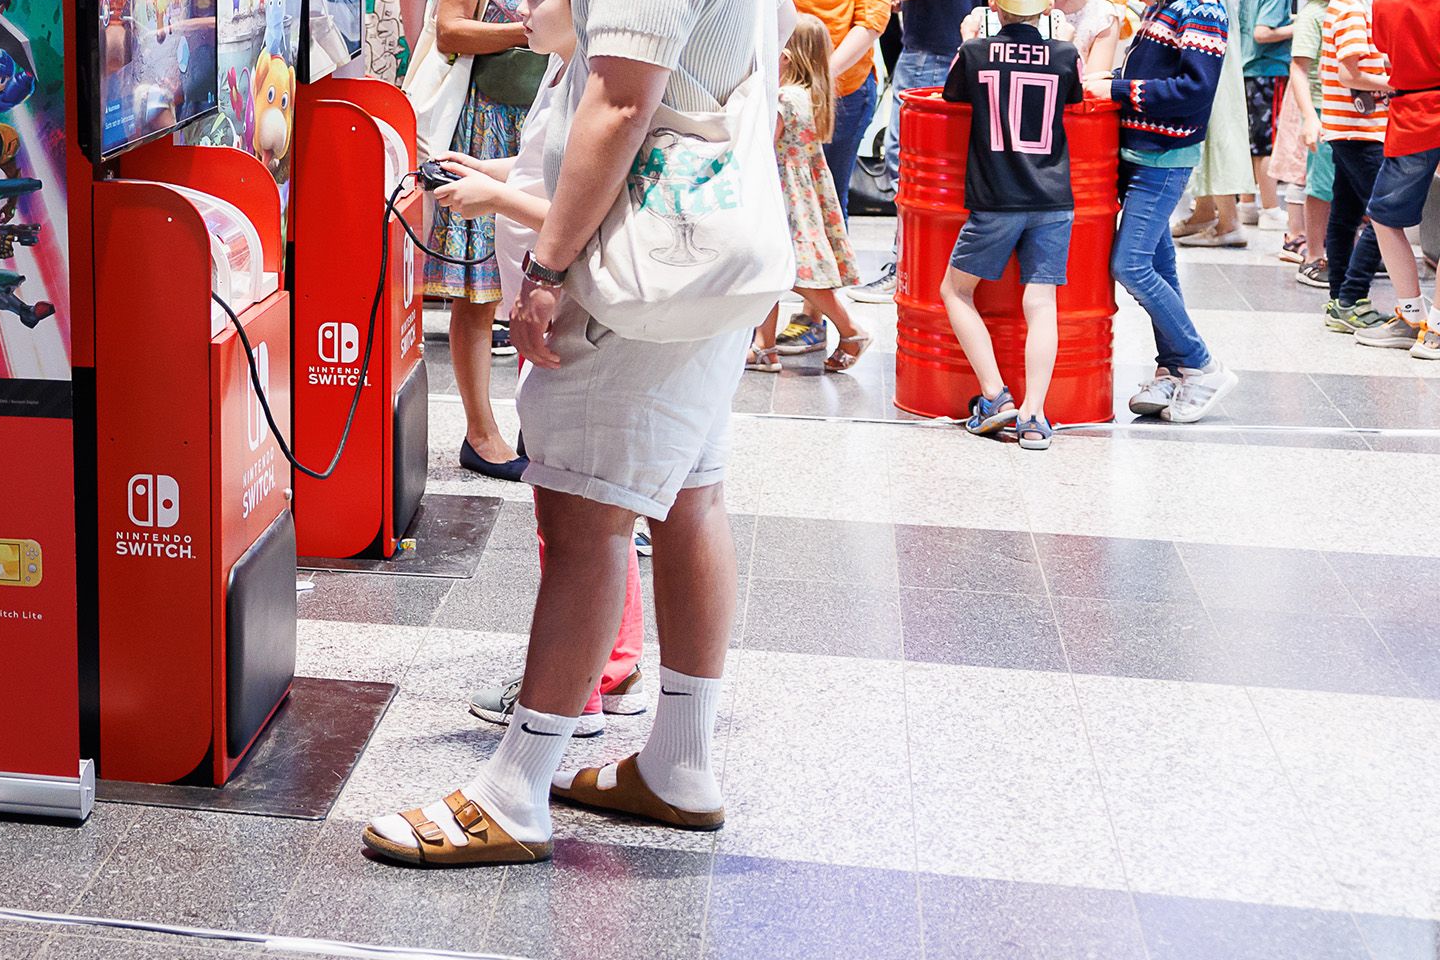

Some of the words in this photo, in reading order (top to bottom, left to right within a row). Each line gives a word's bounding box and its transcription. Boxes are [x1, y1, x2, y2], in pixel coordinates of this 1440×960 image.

[989, 42, 1050, 66] MESSI
[978, 70, 1060, 155] 10
[308, 365, 368, 375] NINTEND
[241, 446, 275, 488] NINTENDO
[241, 469, 276, 520] SWITCH
[116, 531, 192, 543] NINTENDO
[115, 541, 193, 559] SWITCH
[22, 611, 42, 620] Lite
